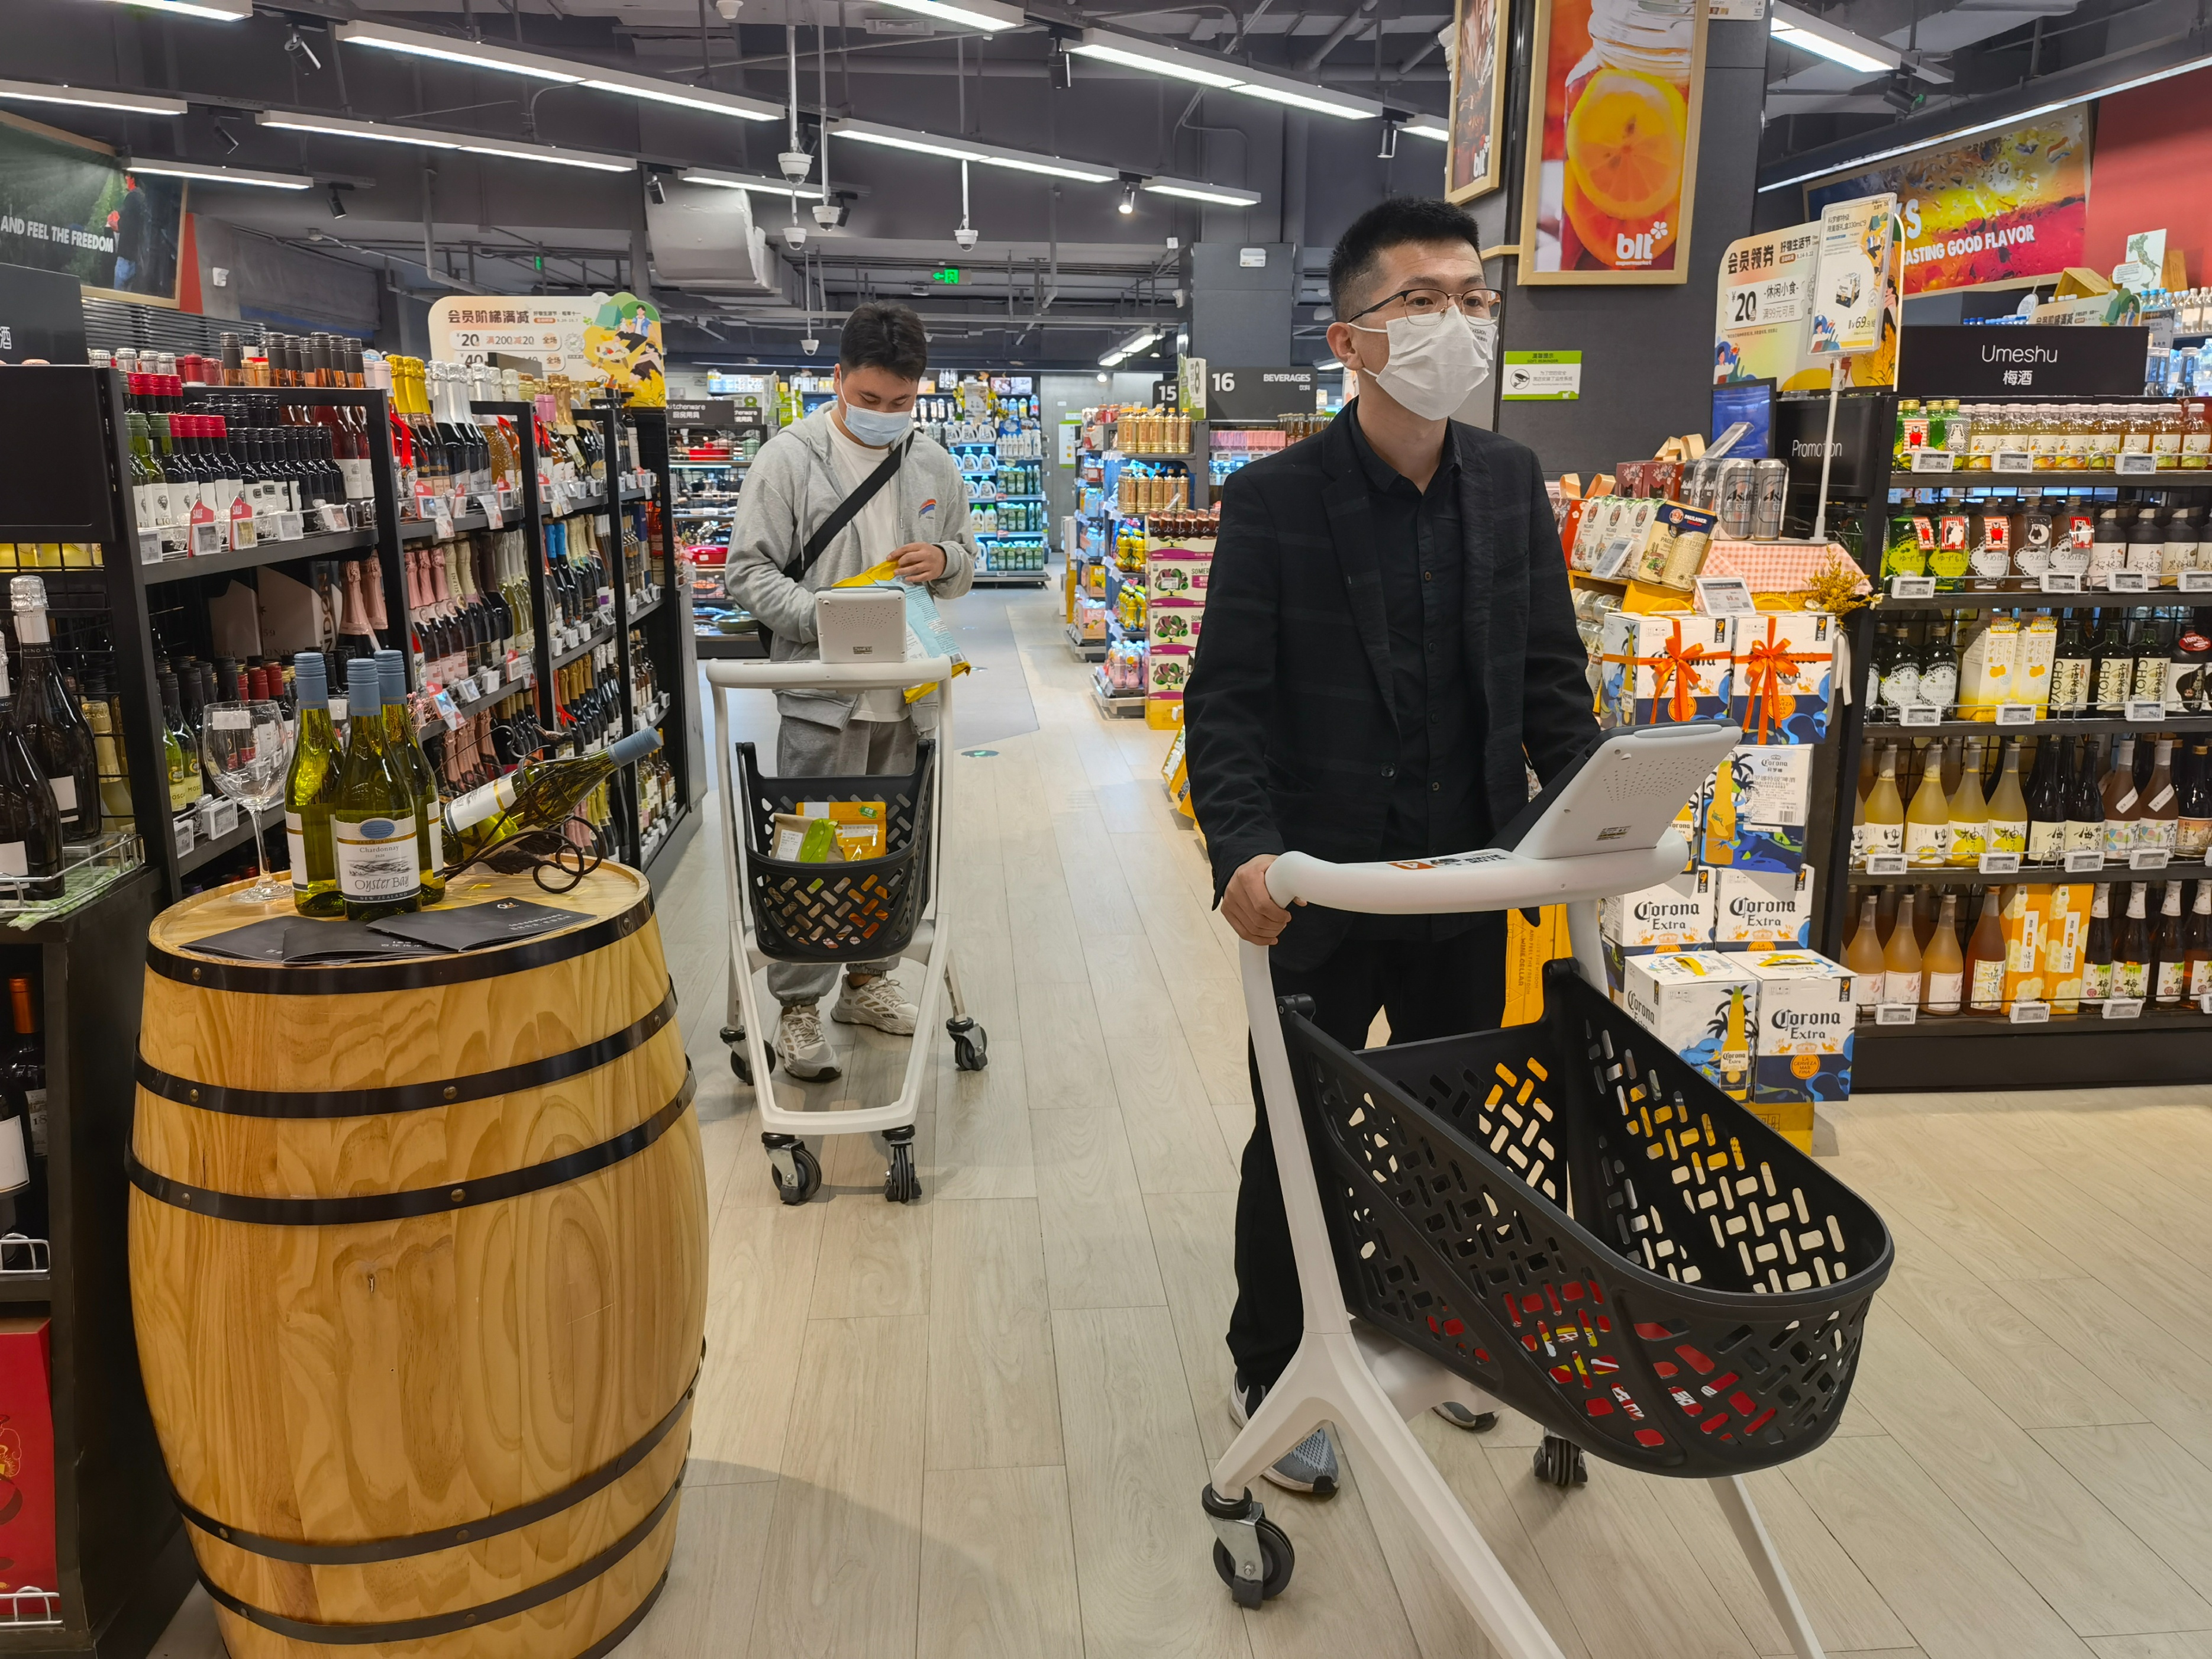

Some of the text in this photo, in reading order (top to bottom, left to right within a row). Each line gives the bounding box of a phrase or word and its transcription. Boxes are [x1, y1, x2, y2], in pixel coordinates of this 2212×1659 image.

[1, 215, 114, 253] AND FEEL THE FREEDOM
[1616, 234, 1655, 259] blt
[1904, 224, 2036, 266] ASTING GOOD FLAVOR
[1727, 244, 1774, 275] 会员领券
[448, 309, 529, 324] 会员阶梯满减
[542, 336, 557, 344] 全场
[547, 357, 561, 365] 全场
[1981, 344, 2058, 363] Umeshu
[1212, 373, 1235, 392] 16
[1263, 374, 1311, 382] BEVERAGES
[2003, 370, 2033, 386] 梅酒
[1159, 386, 1177, 401] 15
[1791, 440, 1843, 458] Promoon
[2050, 660, 2064, 705] CHOYA
[1761, 759, 1788, 767] Corona
[355, 875, 409, 892] Oyster Bay
[1634, 900, 1700, 922] Corona
[1729, 896, 1796, 918] Corona
[1652, 918, 1686, 930] Extra
[1747, 915, 1781, 927] Extra
[1627, 990, 1655, 1025] Corona
[1771, 1008, 1841, 1031] Corona
[1790, 1027, 1826, 1040] Extra
[1722, 1051, 1746, 1060] Corona
